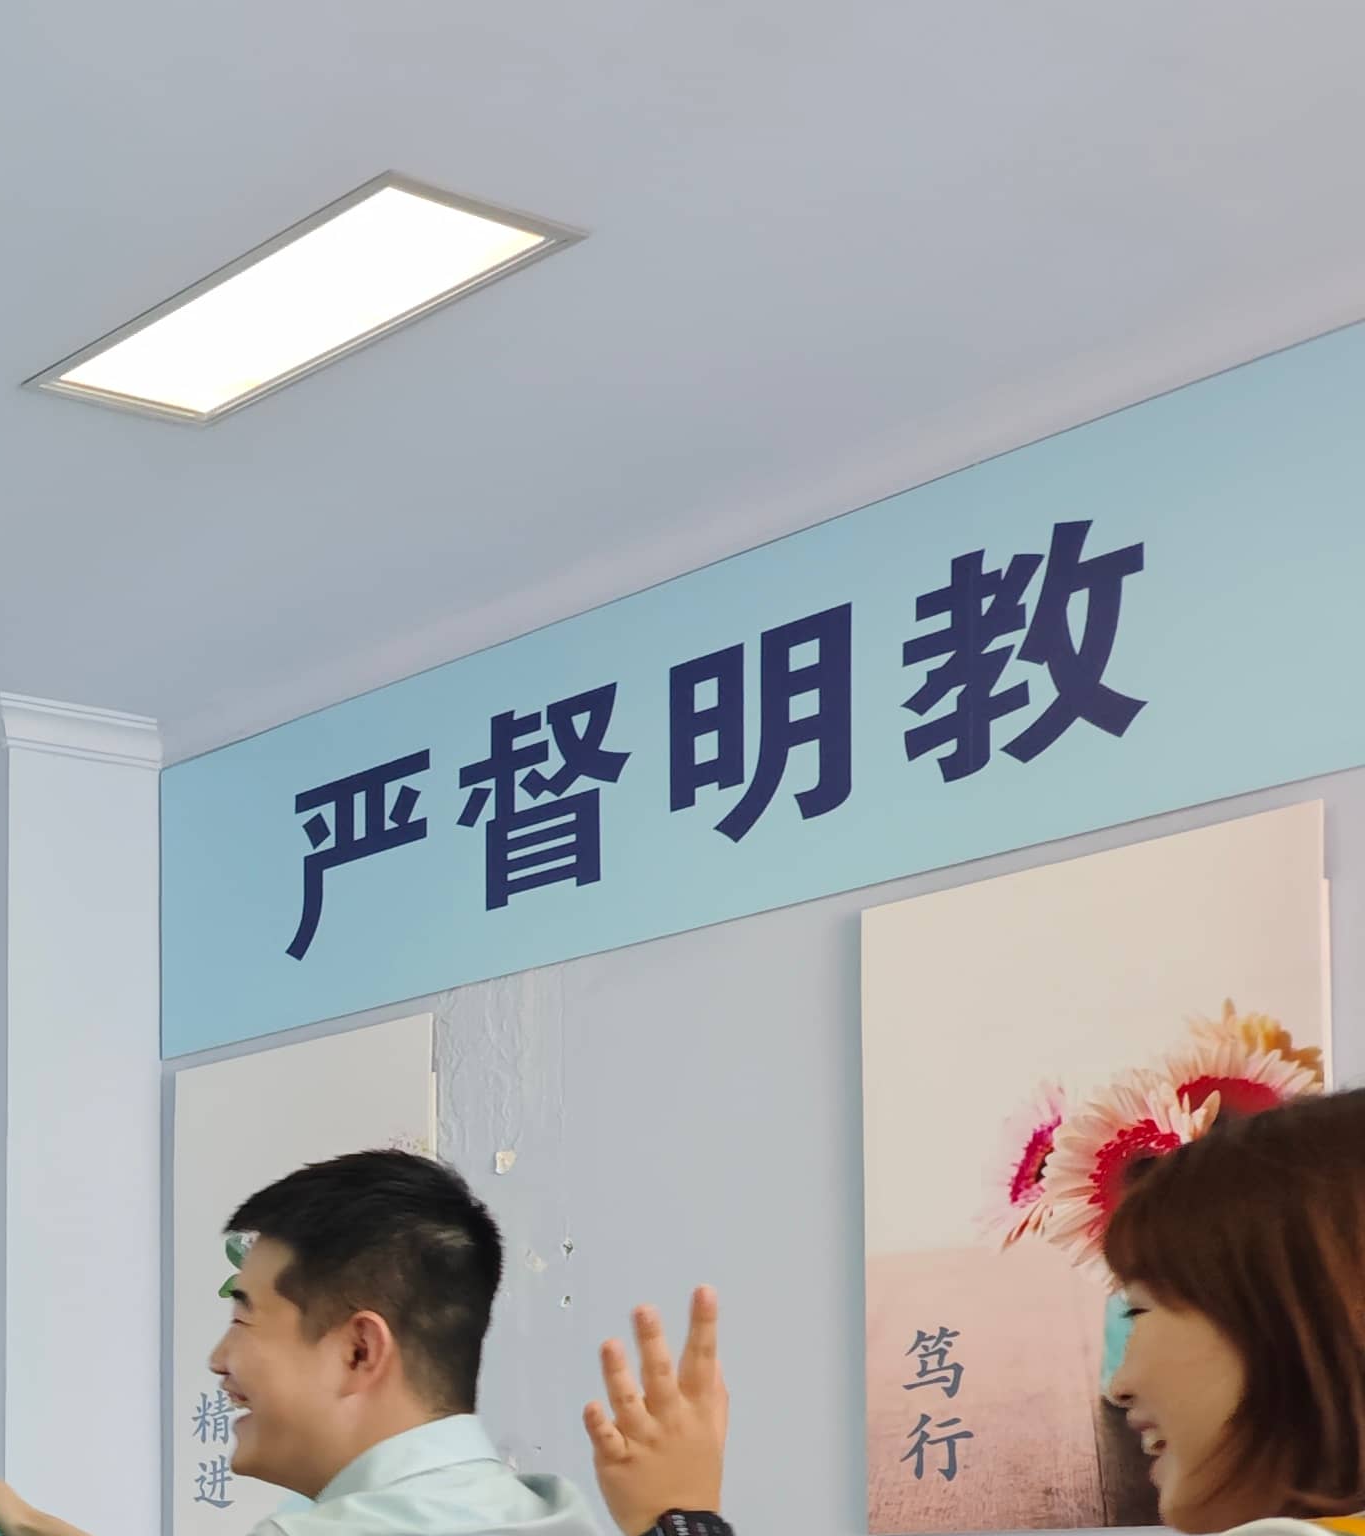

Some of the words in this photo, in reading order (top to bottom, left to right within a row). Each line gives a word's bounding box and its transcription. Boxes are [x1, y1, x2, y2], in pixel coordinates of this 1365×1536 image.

[285, 519, 1149, 962] 严督明教
[191, 1389, 236, 1509] 精进
[899, 1325, 975, 1482] 笃行
